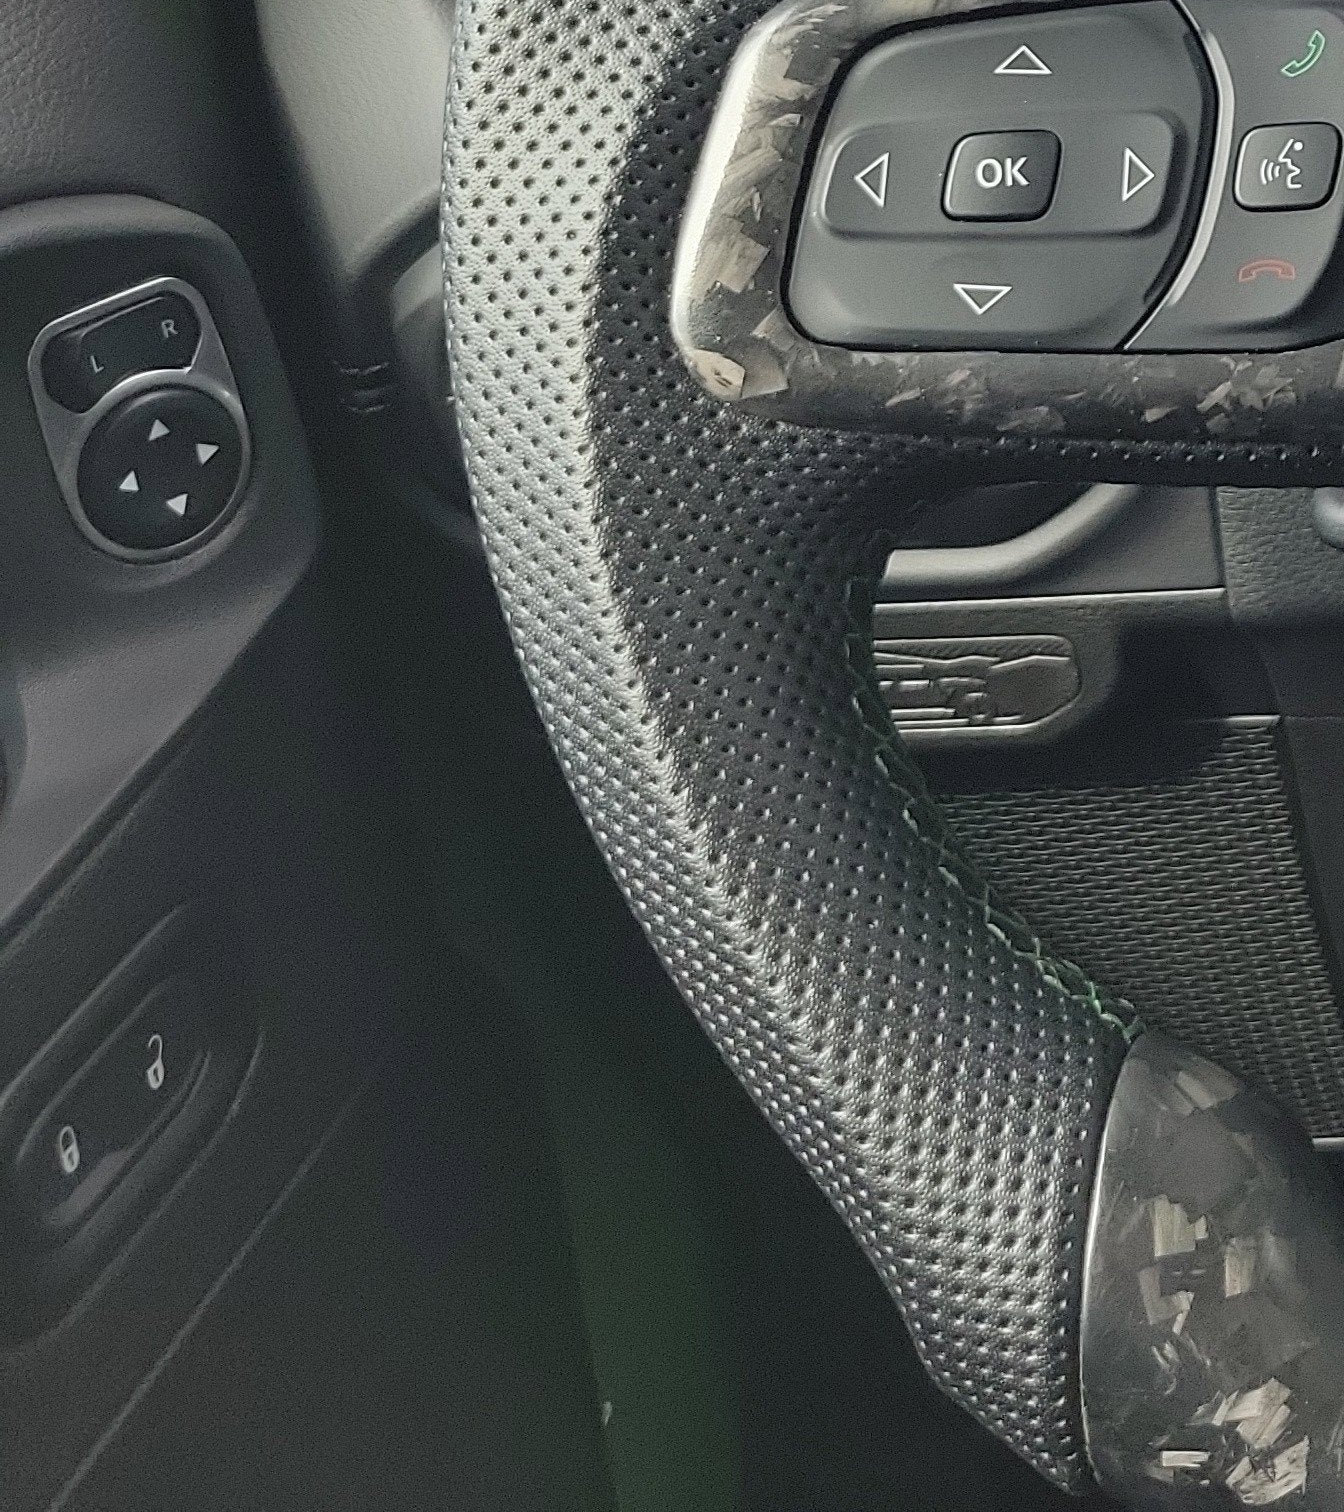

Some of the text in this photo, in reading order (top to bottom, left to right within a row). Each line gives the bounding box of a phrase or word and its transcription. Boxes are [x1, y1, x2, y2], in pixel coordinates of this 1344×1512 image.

[975, 156, 1030, 189] OK
[161, 318, 178, 338] R
[90, 354, 105, 374] L
